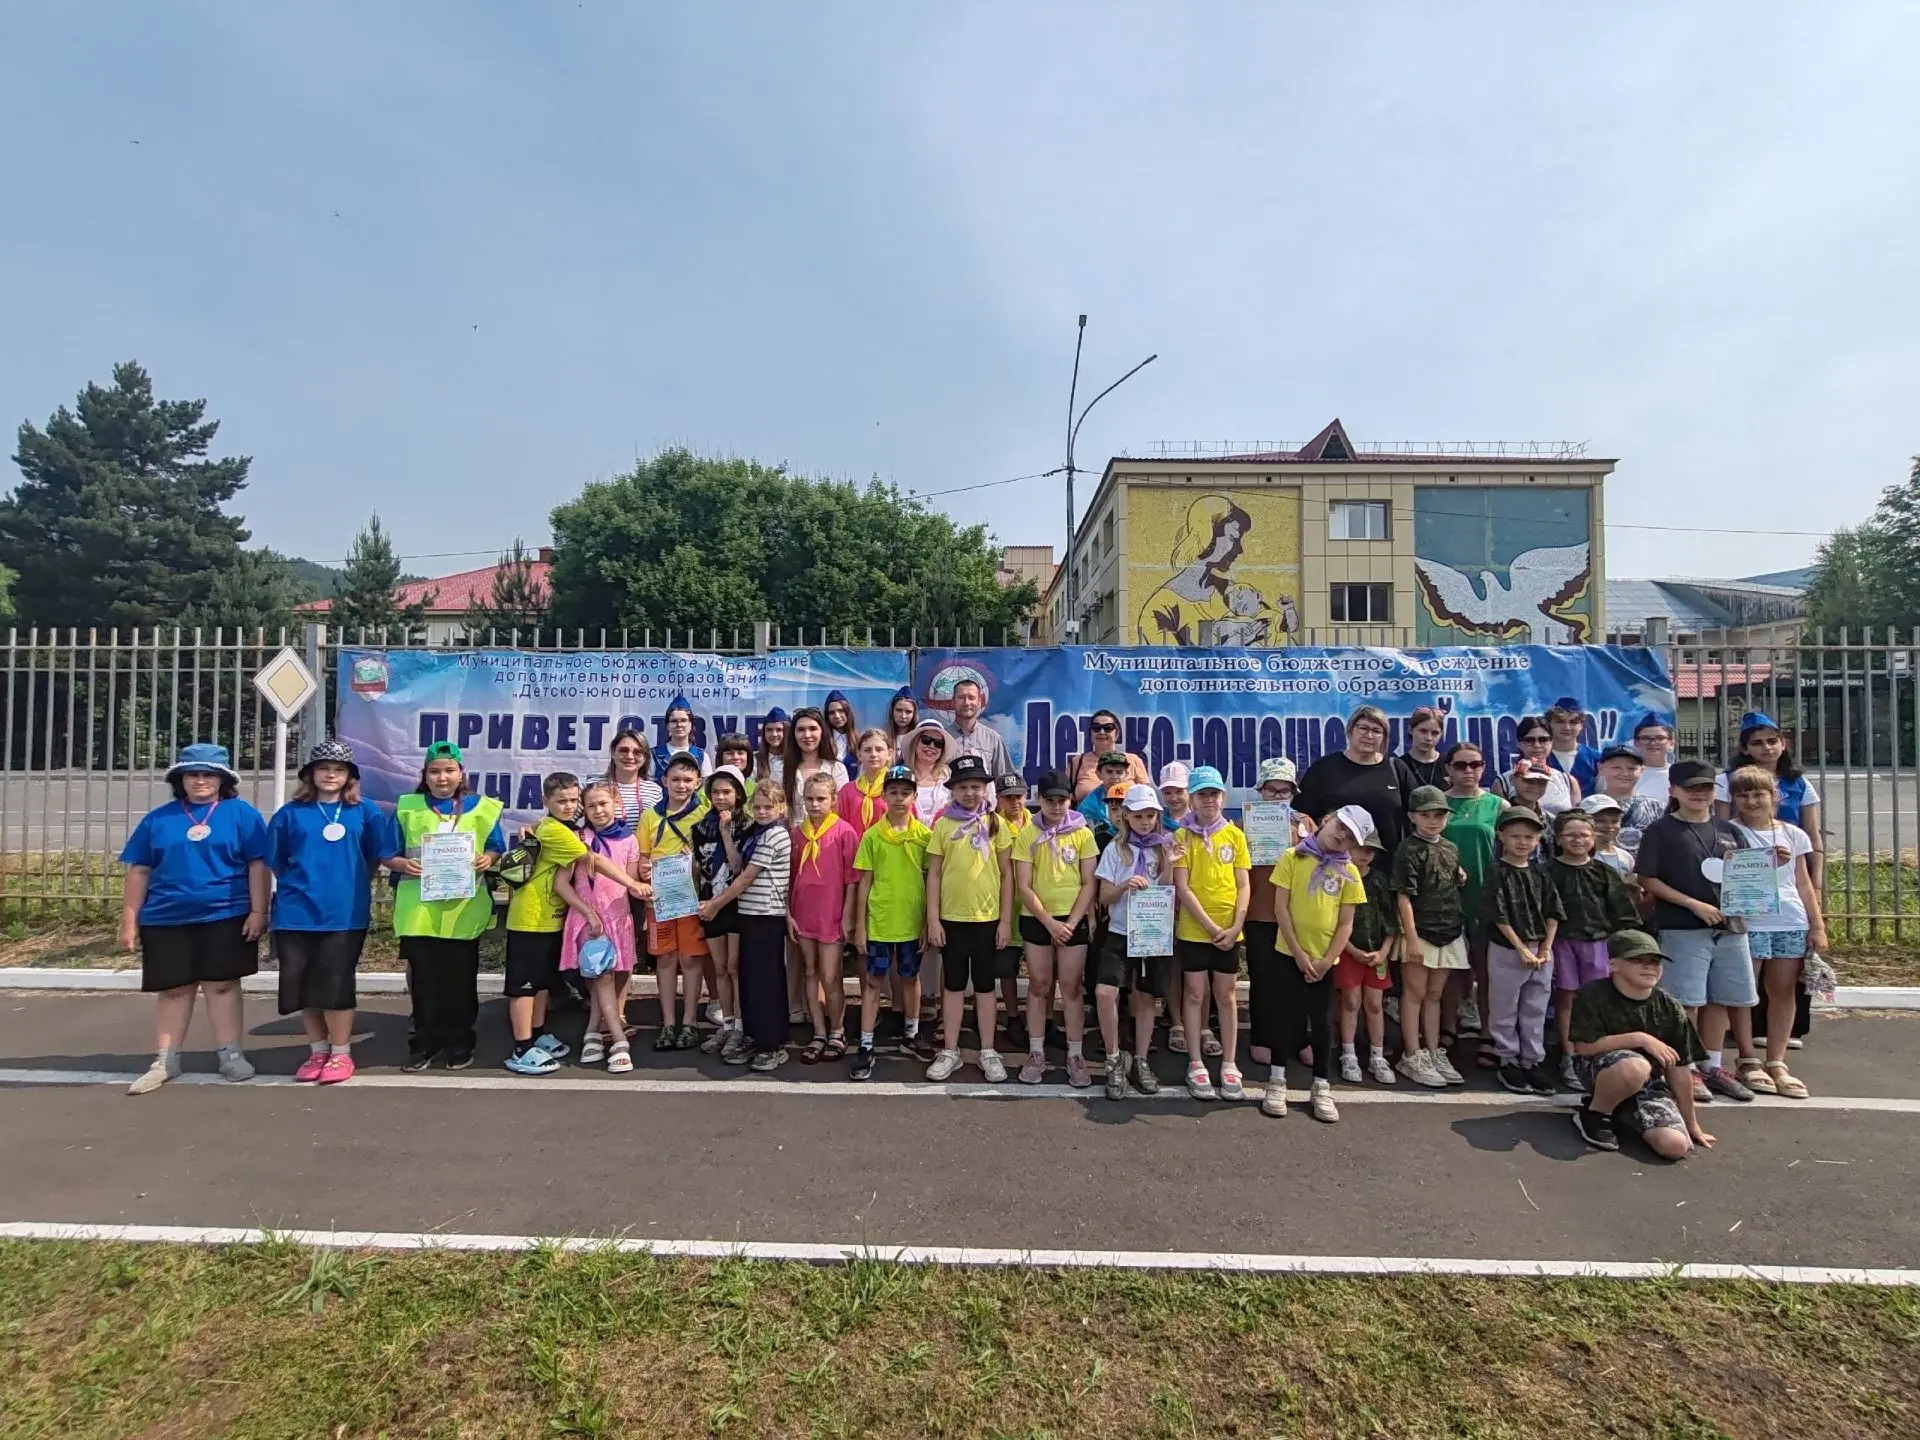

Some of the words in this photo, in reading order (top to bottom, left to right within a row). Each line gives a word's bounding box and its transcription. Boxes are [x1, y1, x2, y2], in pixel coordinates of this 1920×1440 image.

[457, 654, 593, 670] Муниципальное
[601, 655, 698, 670] бюджетное
[706, 656, 809, 672] учреждение
[1085, 653, 1261, 674] Муниципальное
[1267, 654, 1394, 672] бюджетное
[494, 671, 649, 684] дополнительного
[657, 670, 767, 687] образования
[1140, 678, 1330, 693] дополнительного
[1337, 676, 1475, 695] образования
